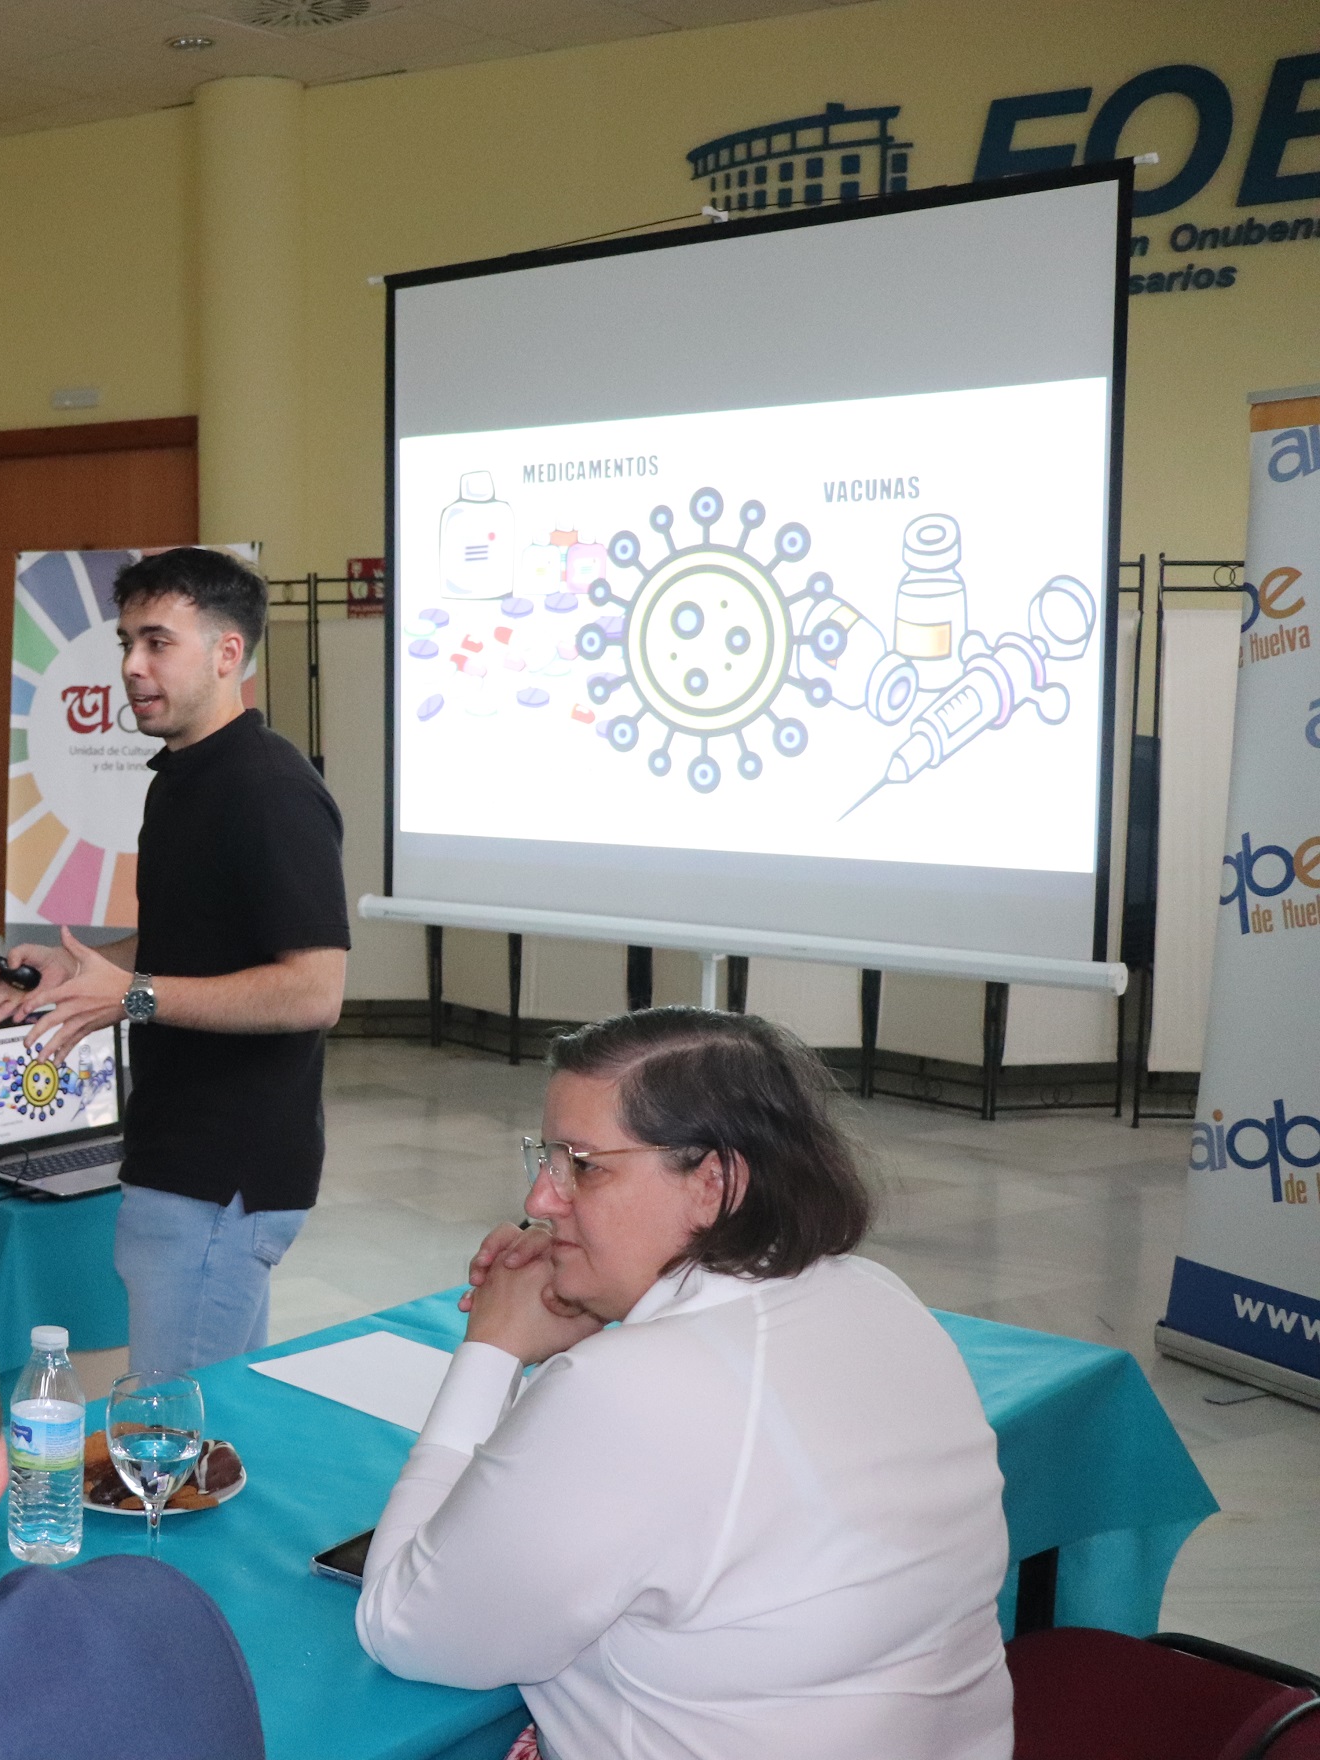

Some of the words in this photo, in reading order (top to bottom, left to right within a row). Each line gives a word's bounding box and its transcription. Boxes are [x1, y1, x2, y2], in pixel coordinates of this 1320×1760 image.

[1169, 216, 1320, 253] Onuben
[523, 455, 659, 484] MEDICAMENTOS
[823, 476, 921, 503] VACUNAS
[1249, 624, 1311, 663] Huelva
[69, 745, 105, 756] Unidad
[107, 745, 120, 756] de
[121, 745, 157, 756] Cultura
[101, 761, 114, 771] de
[116, 761, 125, 771] la
[1251, 904, 1273, 934] de
[1285, 1172, 1307, 1205] de
